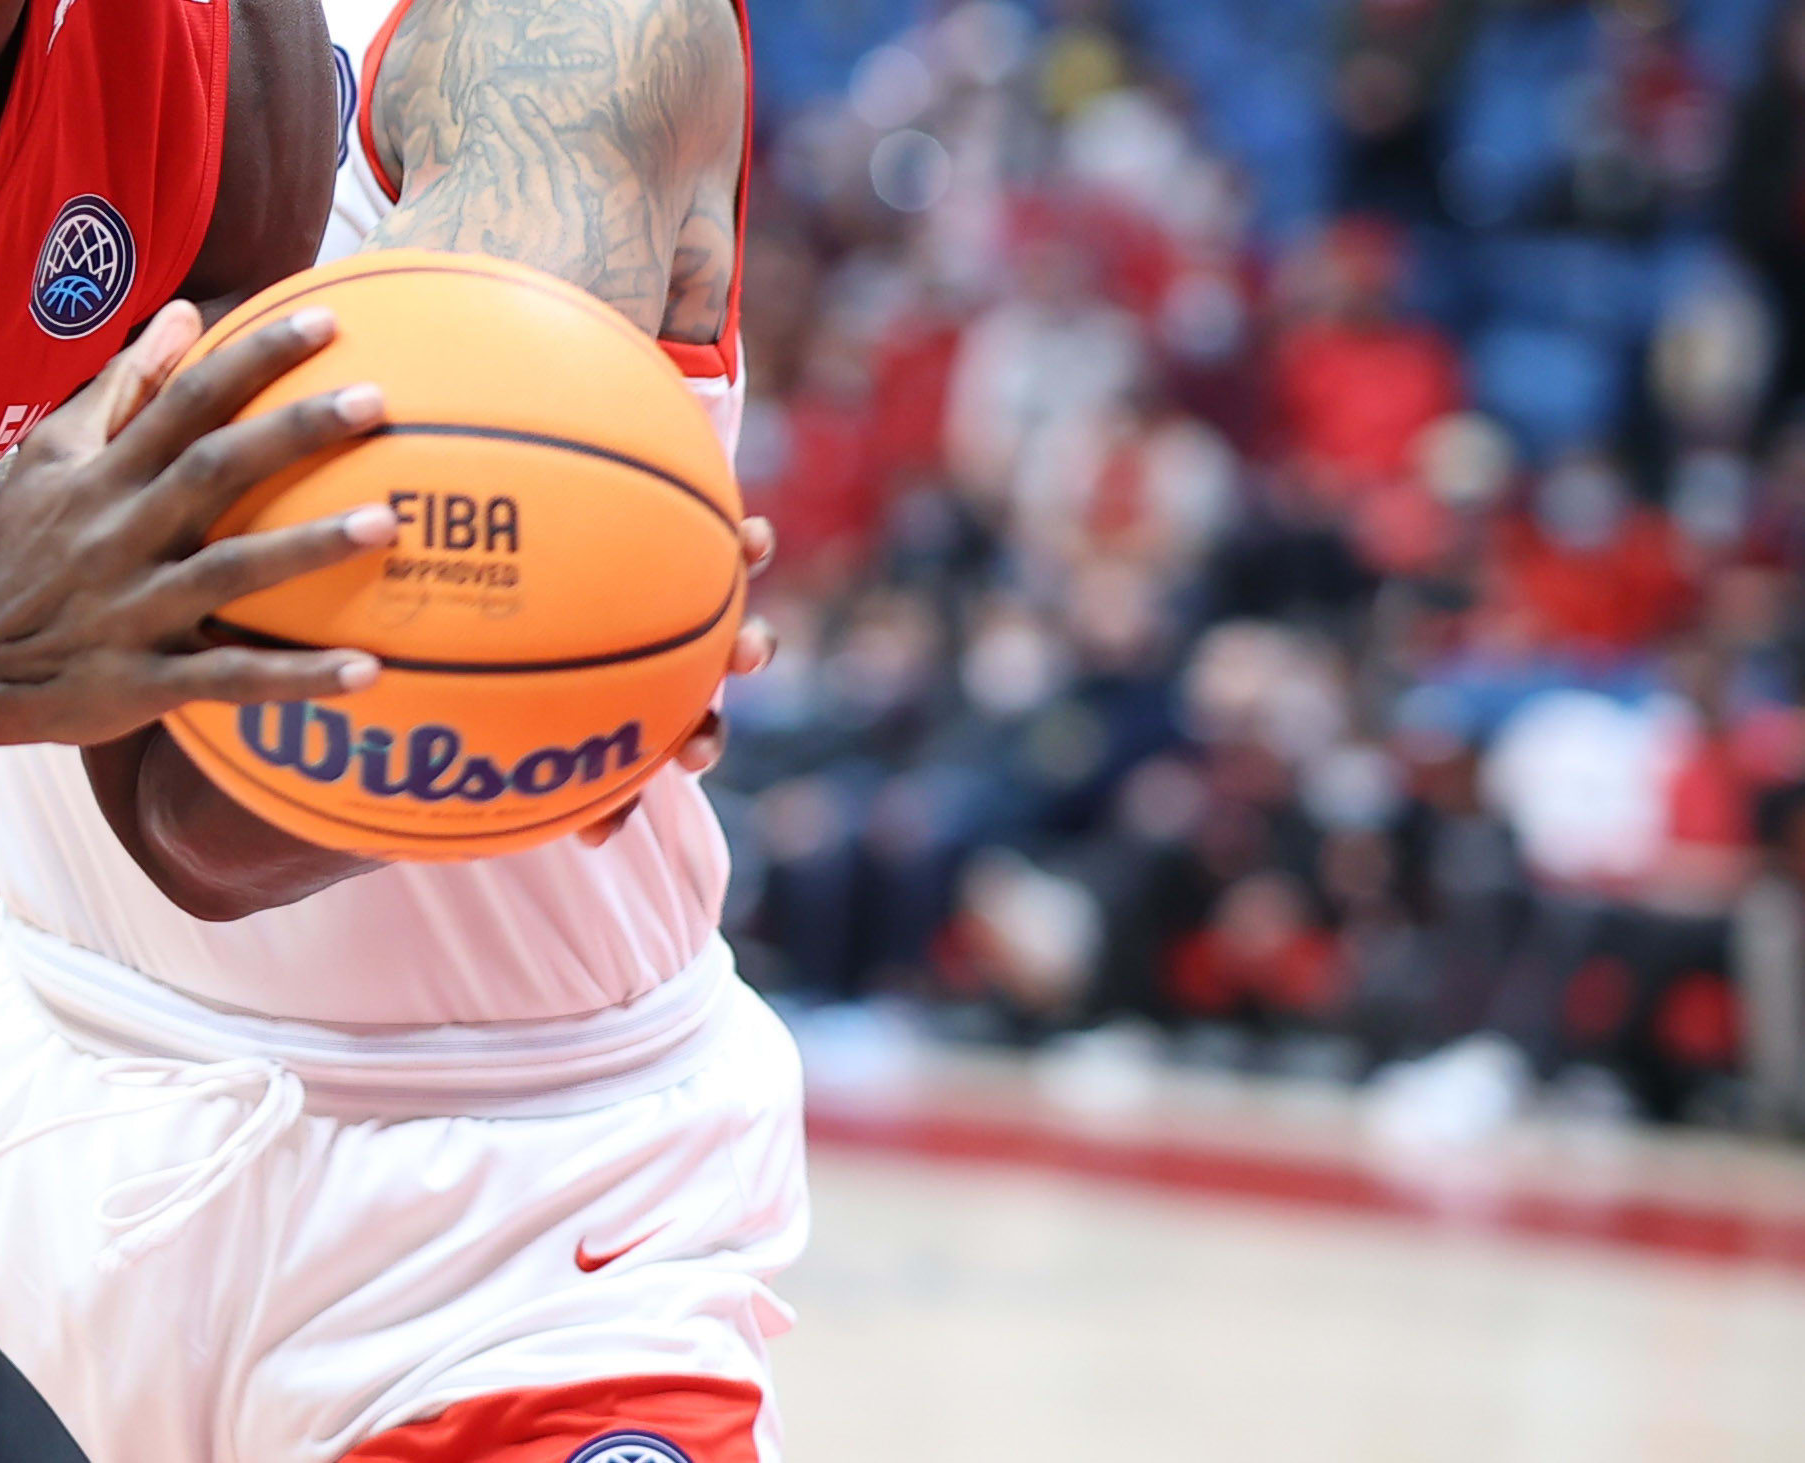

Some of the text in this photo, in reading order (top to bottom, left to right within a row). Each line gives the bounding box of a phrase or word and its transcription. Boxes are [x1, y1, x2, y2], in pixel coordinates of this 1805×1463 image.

[387, 490, 519, 552] FIBA
[384, 556, 520, 587] APPROVED
[237, 699, 642, 804] Wilson
